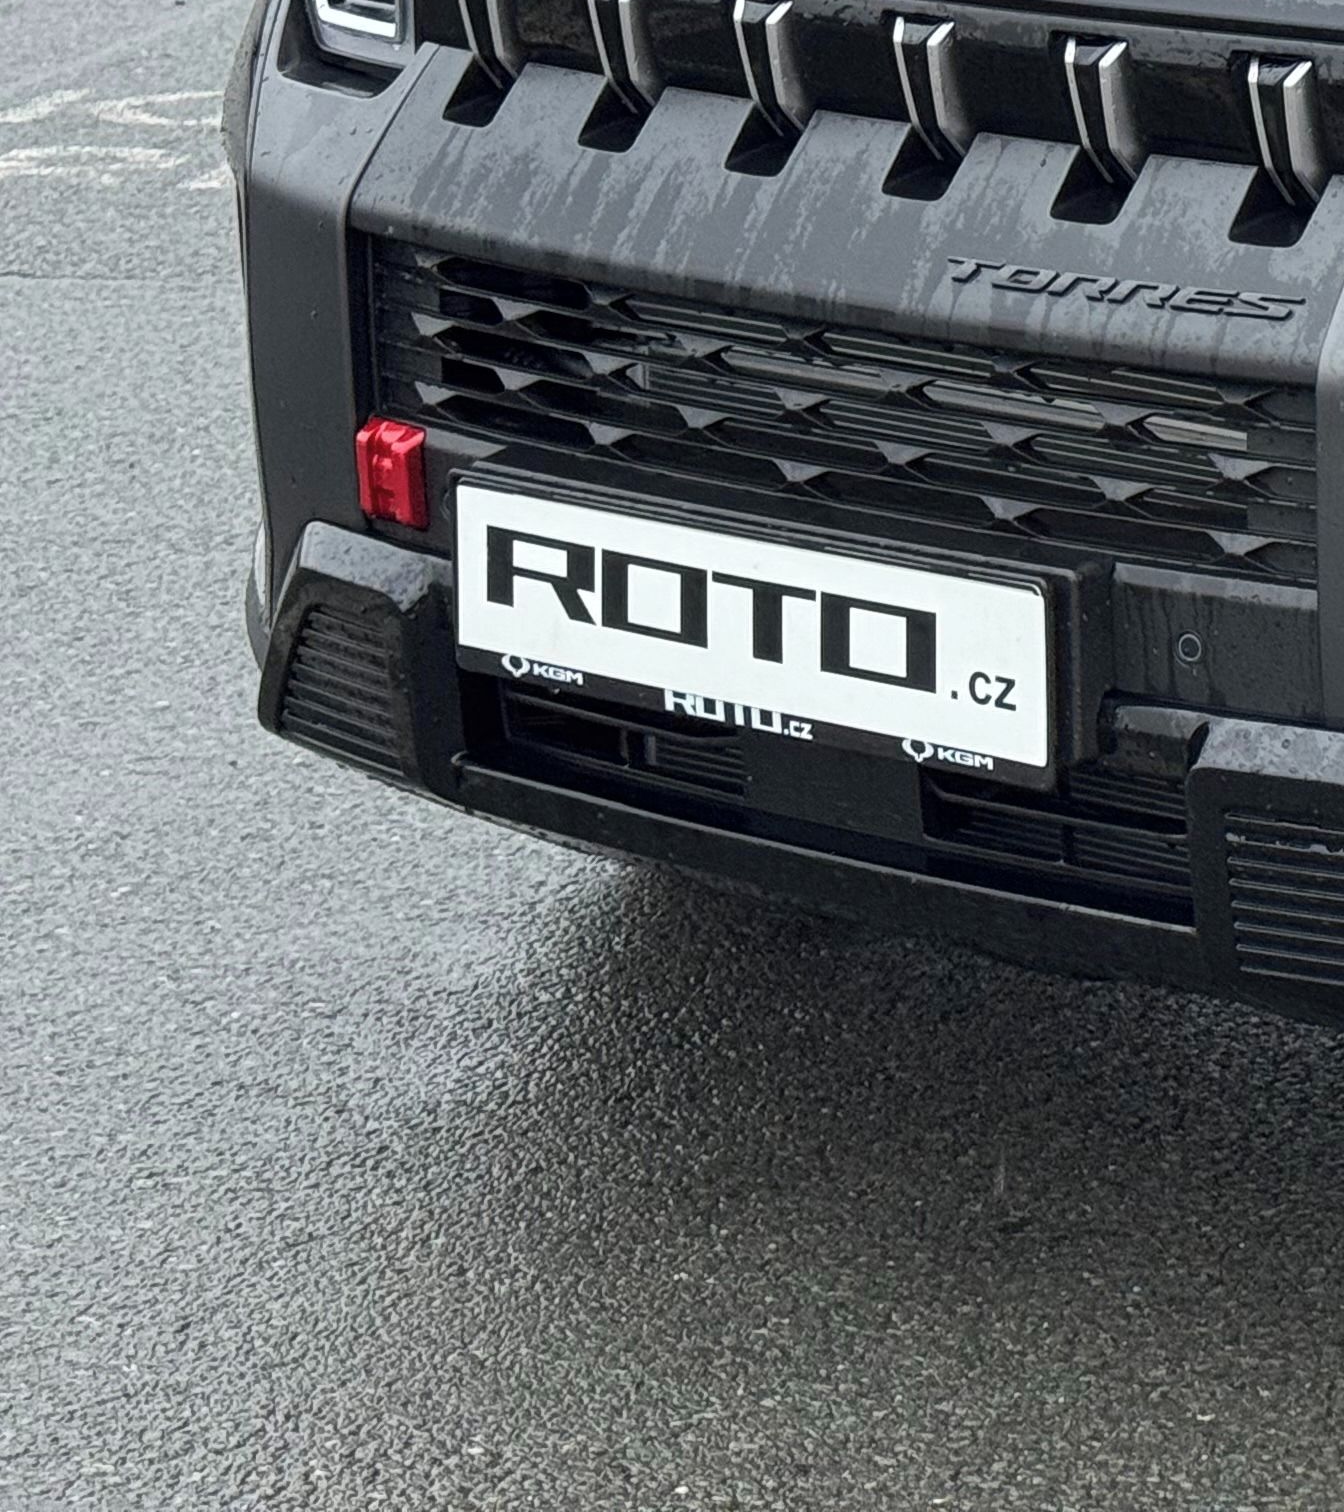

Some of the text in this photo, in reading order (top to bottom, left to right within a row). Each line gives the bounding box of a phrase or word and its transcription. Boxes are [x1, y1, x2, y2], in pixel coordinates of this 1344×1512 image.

[948, 256, 1306, 322] TORRES
[532, 663, 584, 686] KGM
[936, 750, 994, 771] KGM
